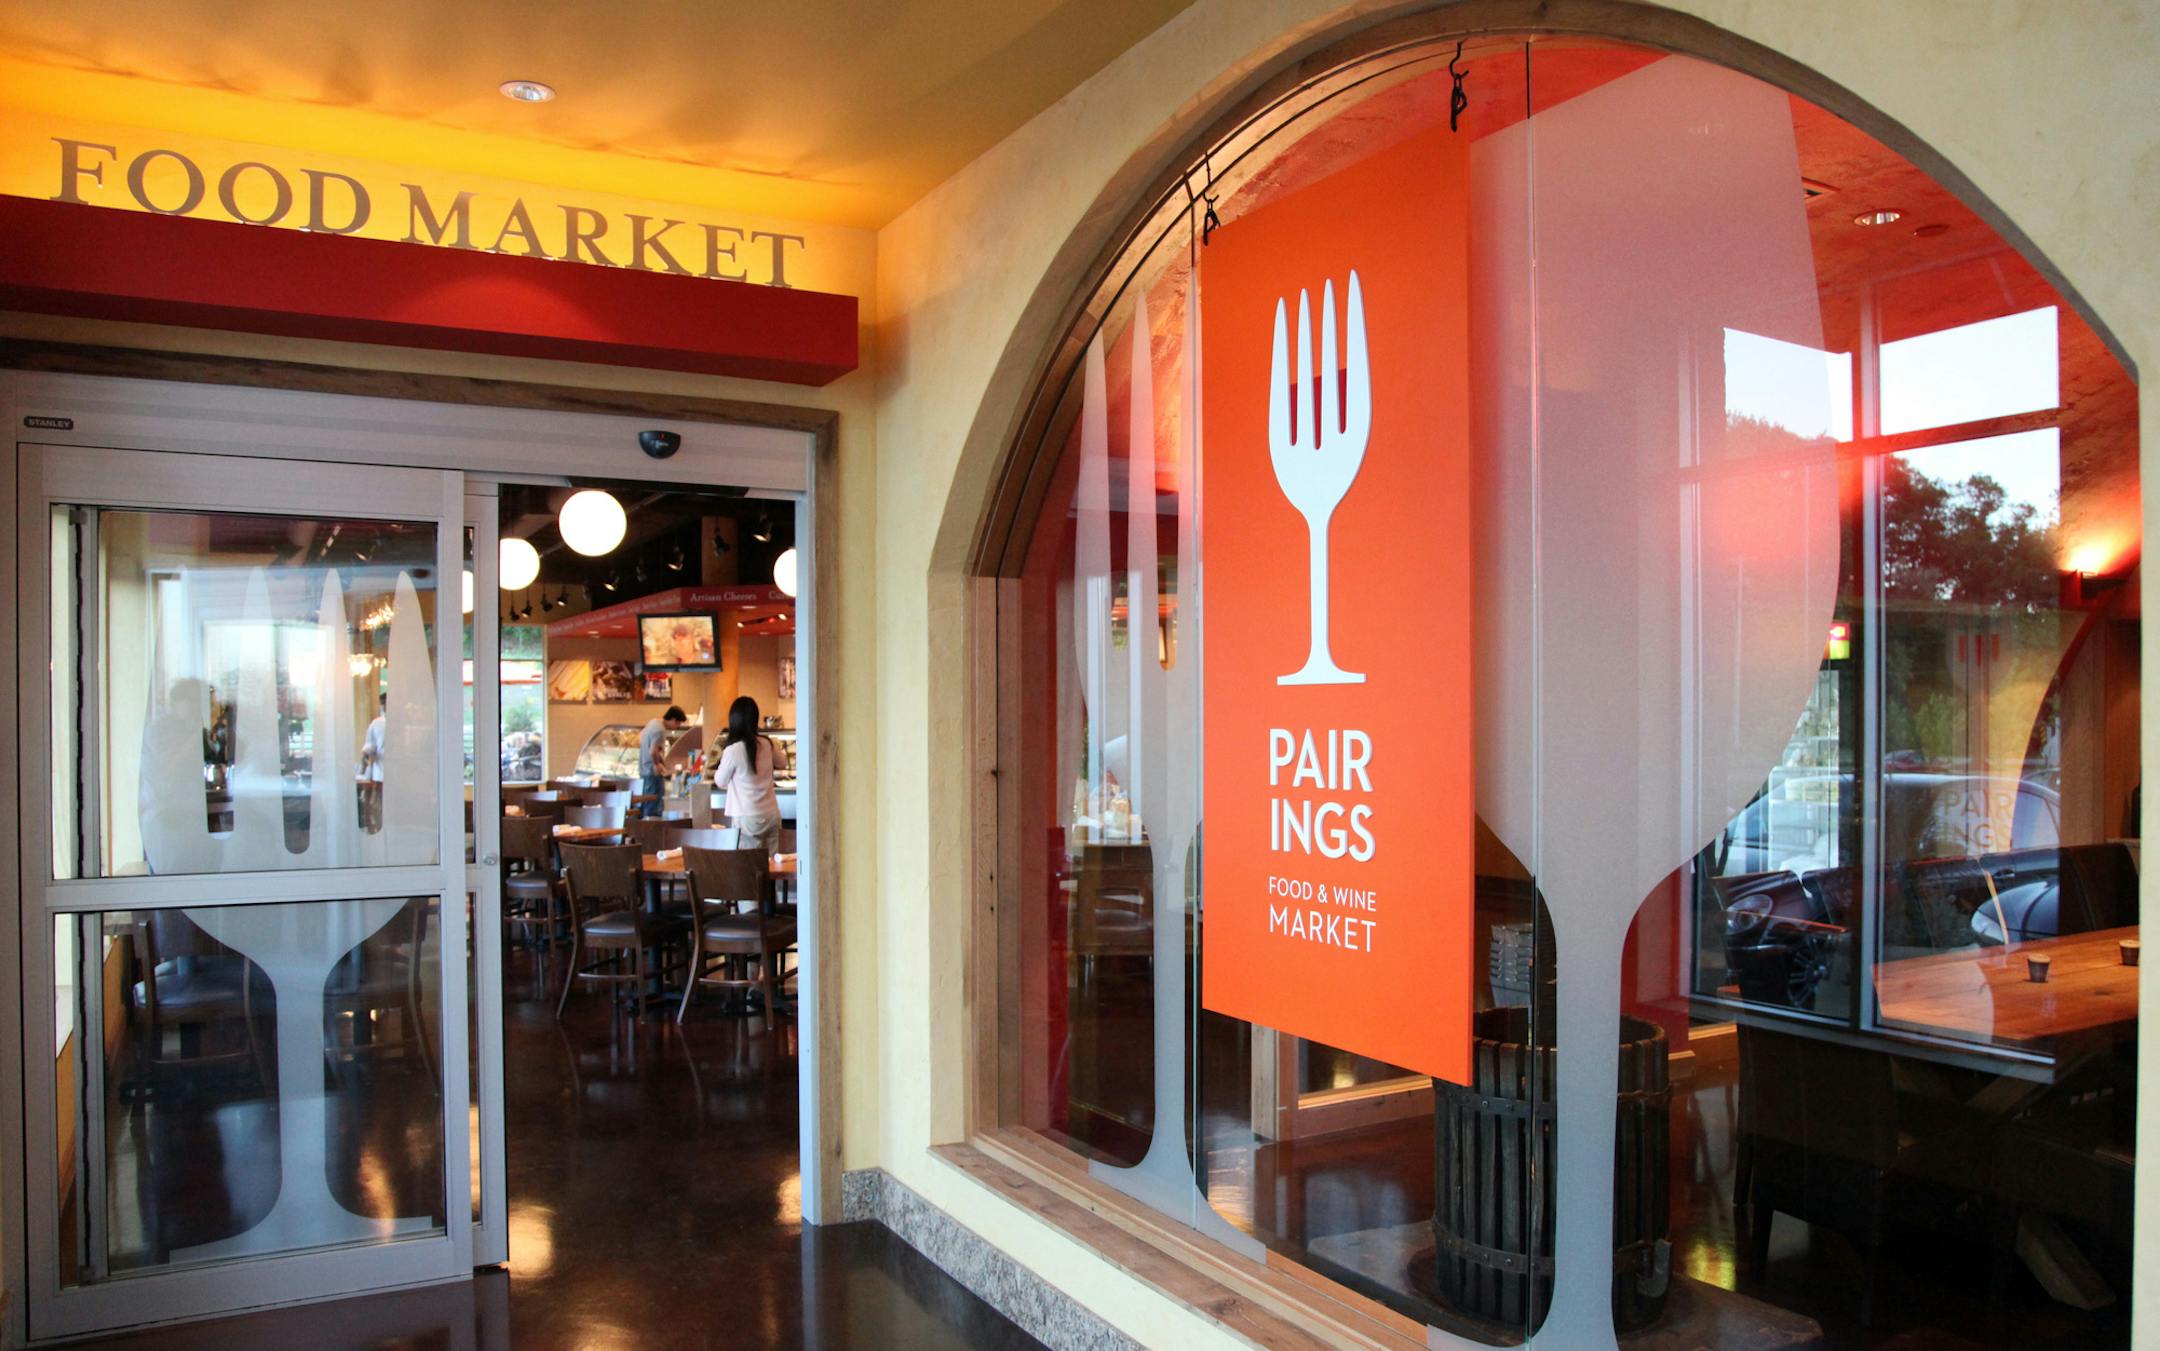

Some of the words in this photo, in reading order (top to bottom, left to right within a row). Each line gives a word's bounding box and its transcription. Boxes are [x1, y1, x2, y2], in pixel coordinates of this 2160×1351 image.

[49, 137, 371, 234] FOOD
[400, 182, 805, 288] MARKET
[28, 418, 70, 428] STANLEY
[690, 592, 722, 602] Artisan
[723, 591, 758, 601] Cheeses
[1269, 728, 1374, 793] PAIR
[1269, 798, 1376, 863] INGS
[1268, 875, 1313, 901] FOOD
[1317, 883, 1328, 904] &
[1333, 886, 1377, 912] WINE
[1269, 903, 1377, 953] MARKET
